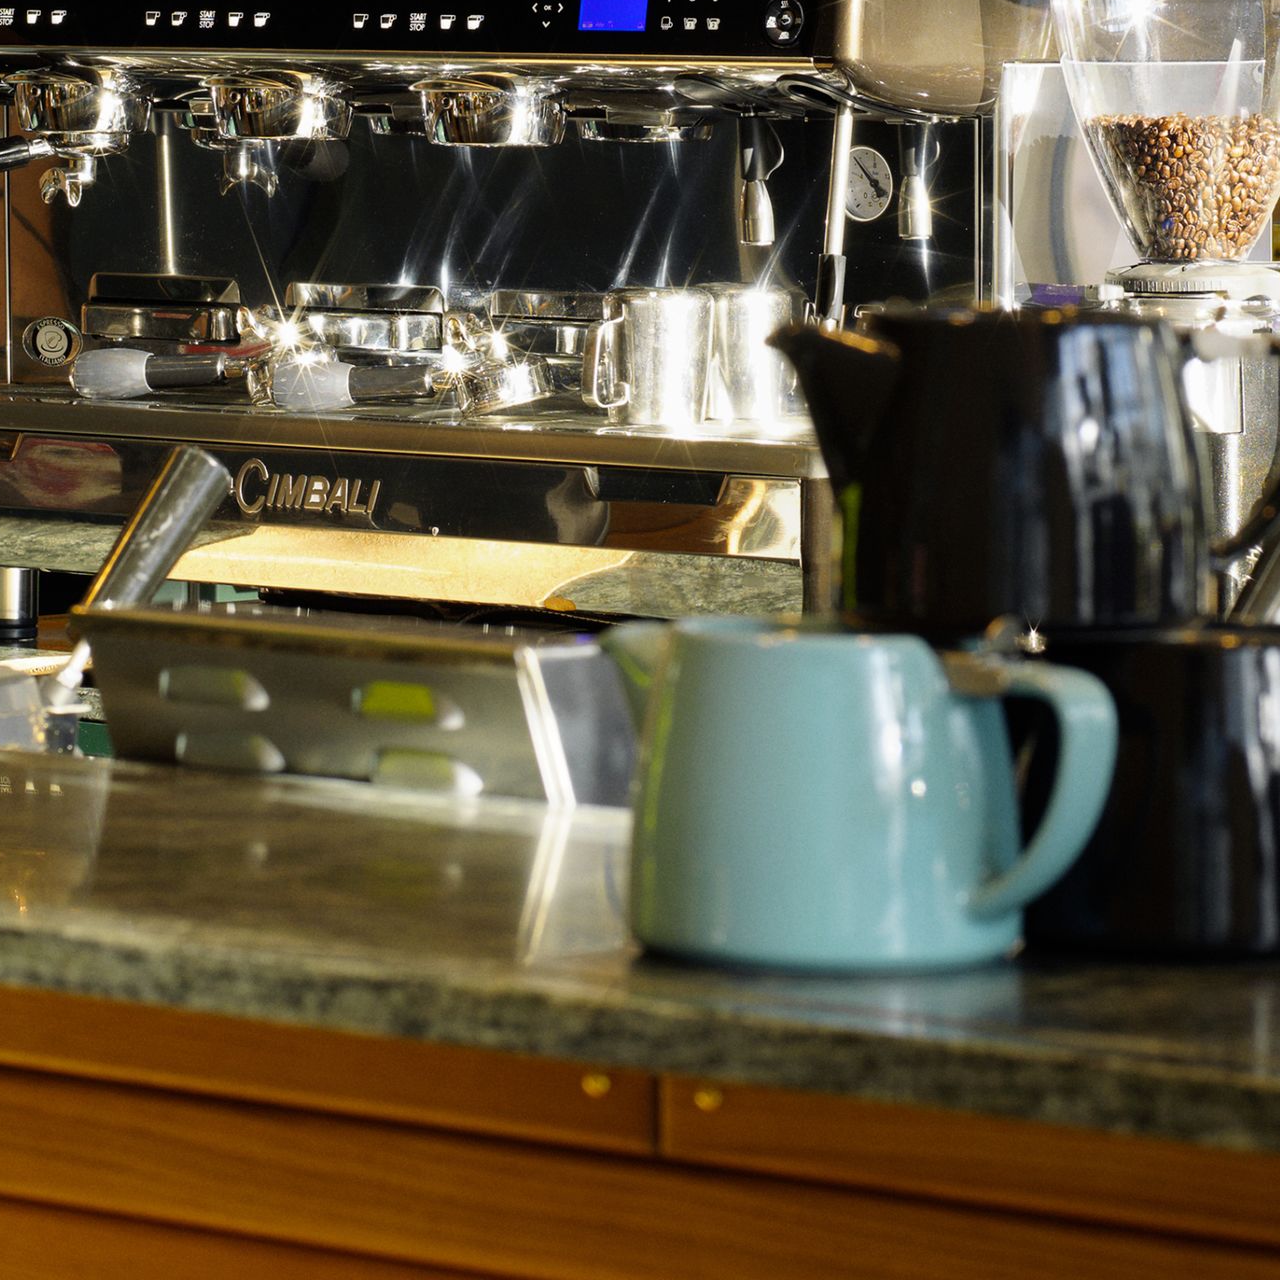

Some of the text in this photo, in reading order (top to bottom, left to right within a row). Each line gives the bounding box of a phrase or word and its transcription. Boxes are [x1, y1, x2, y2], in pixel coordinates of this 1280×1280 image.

[0, 7, 15, 16] START
[199, 10, 216, 19] START
[410, 12, 427, 21] START
[198, 20, 215, 29] STOP
[409, 23, 426, 31] STOP
[37, 319, 66, 330] ESPRESSO
[39, 354, 66, 365] ITALIANO
[235, 457, 381, 514] CIMBALI
